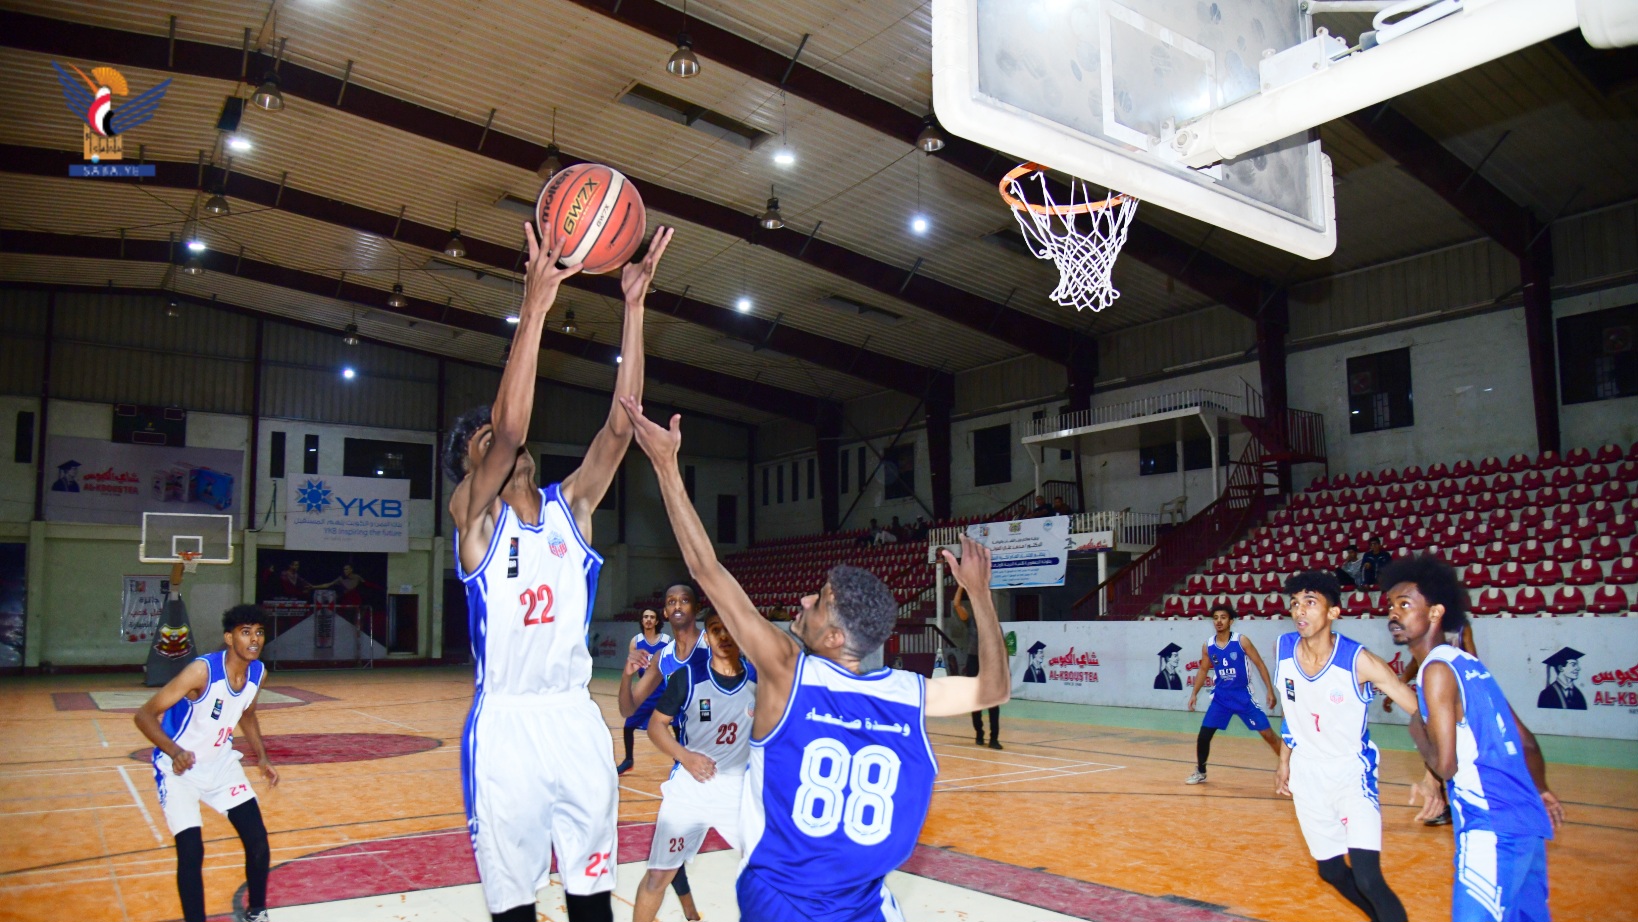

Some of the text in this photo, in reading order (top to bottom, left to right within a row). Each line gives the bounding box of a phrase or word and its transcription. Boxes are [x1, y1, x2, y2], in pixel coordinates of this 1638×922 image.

[563, 177, 599, 236] GW7X
[335, 496, 402, 518] YKB
[519, 584, 555, 627] 22
[1049, 646, 1099, 668] شاي الكبوس
[1222, 657, 1229, 667] 6
[1049, 670, 1099, 682] AL-KBOUS TEA
[1310, 712, 1321, 732] 7
[715, 722, 738, 745] 23
[791, 737, 902, 846] 88
[669, 837, 685, 853] 23
